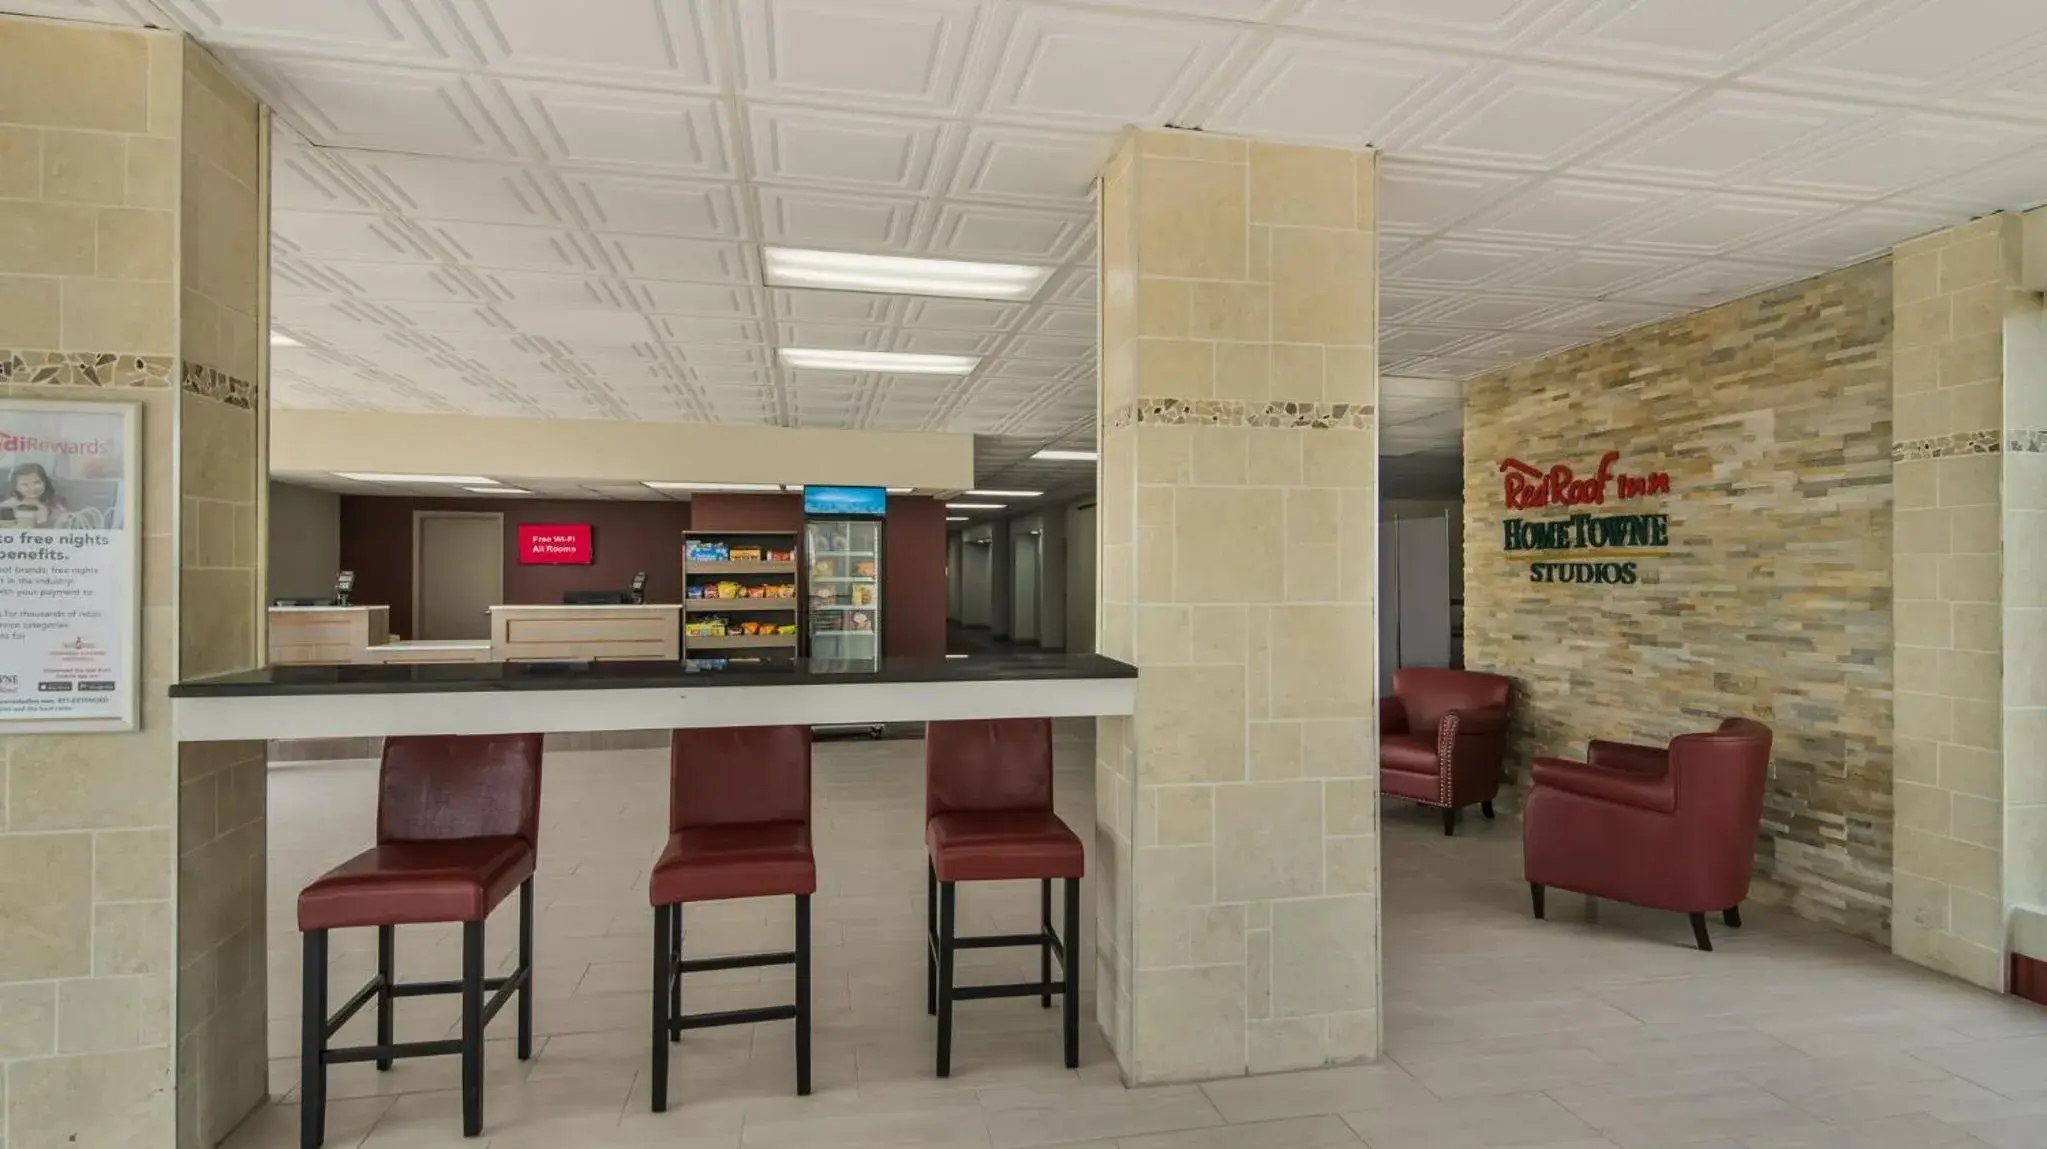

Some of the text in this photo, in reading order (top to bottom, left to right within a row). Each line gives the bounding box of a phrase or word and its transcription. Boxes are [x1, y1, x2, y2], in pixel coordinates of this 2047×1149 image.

[0, 433, 107, 454] diRewards
[20, 532, 54, 544] free
[59, 533, 109, 548] nights
[532, 535, 552, 543] Free
[532, 545, 577, 553] All Rooms
[1530, 562, 1637, 585] STUDIOS
